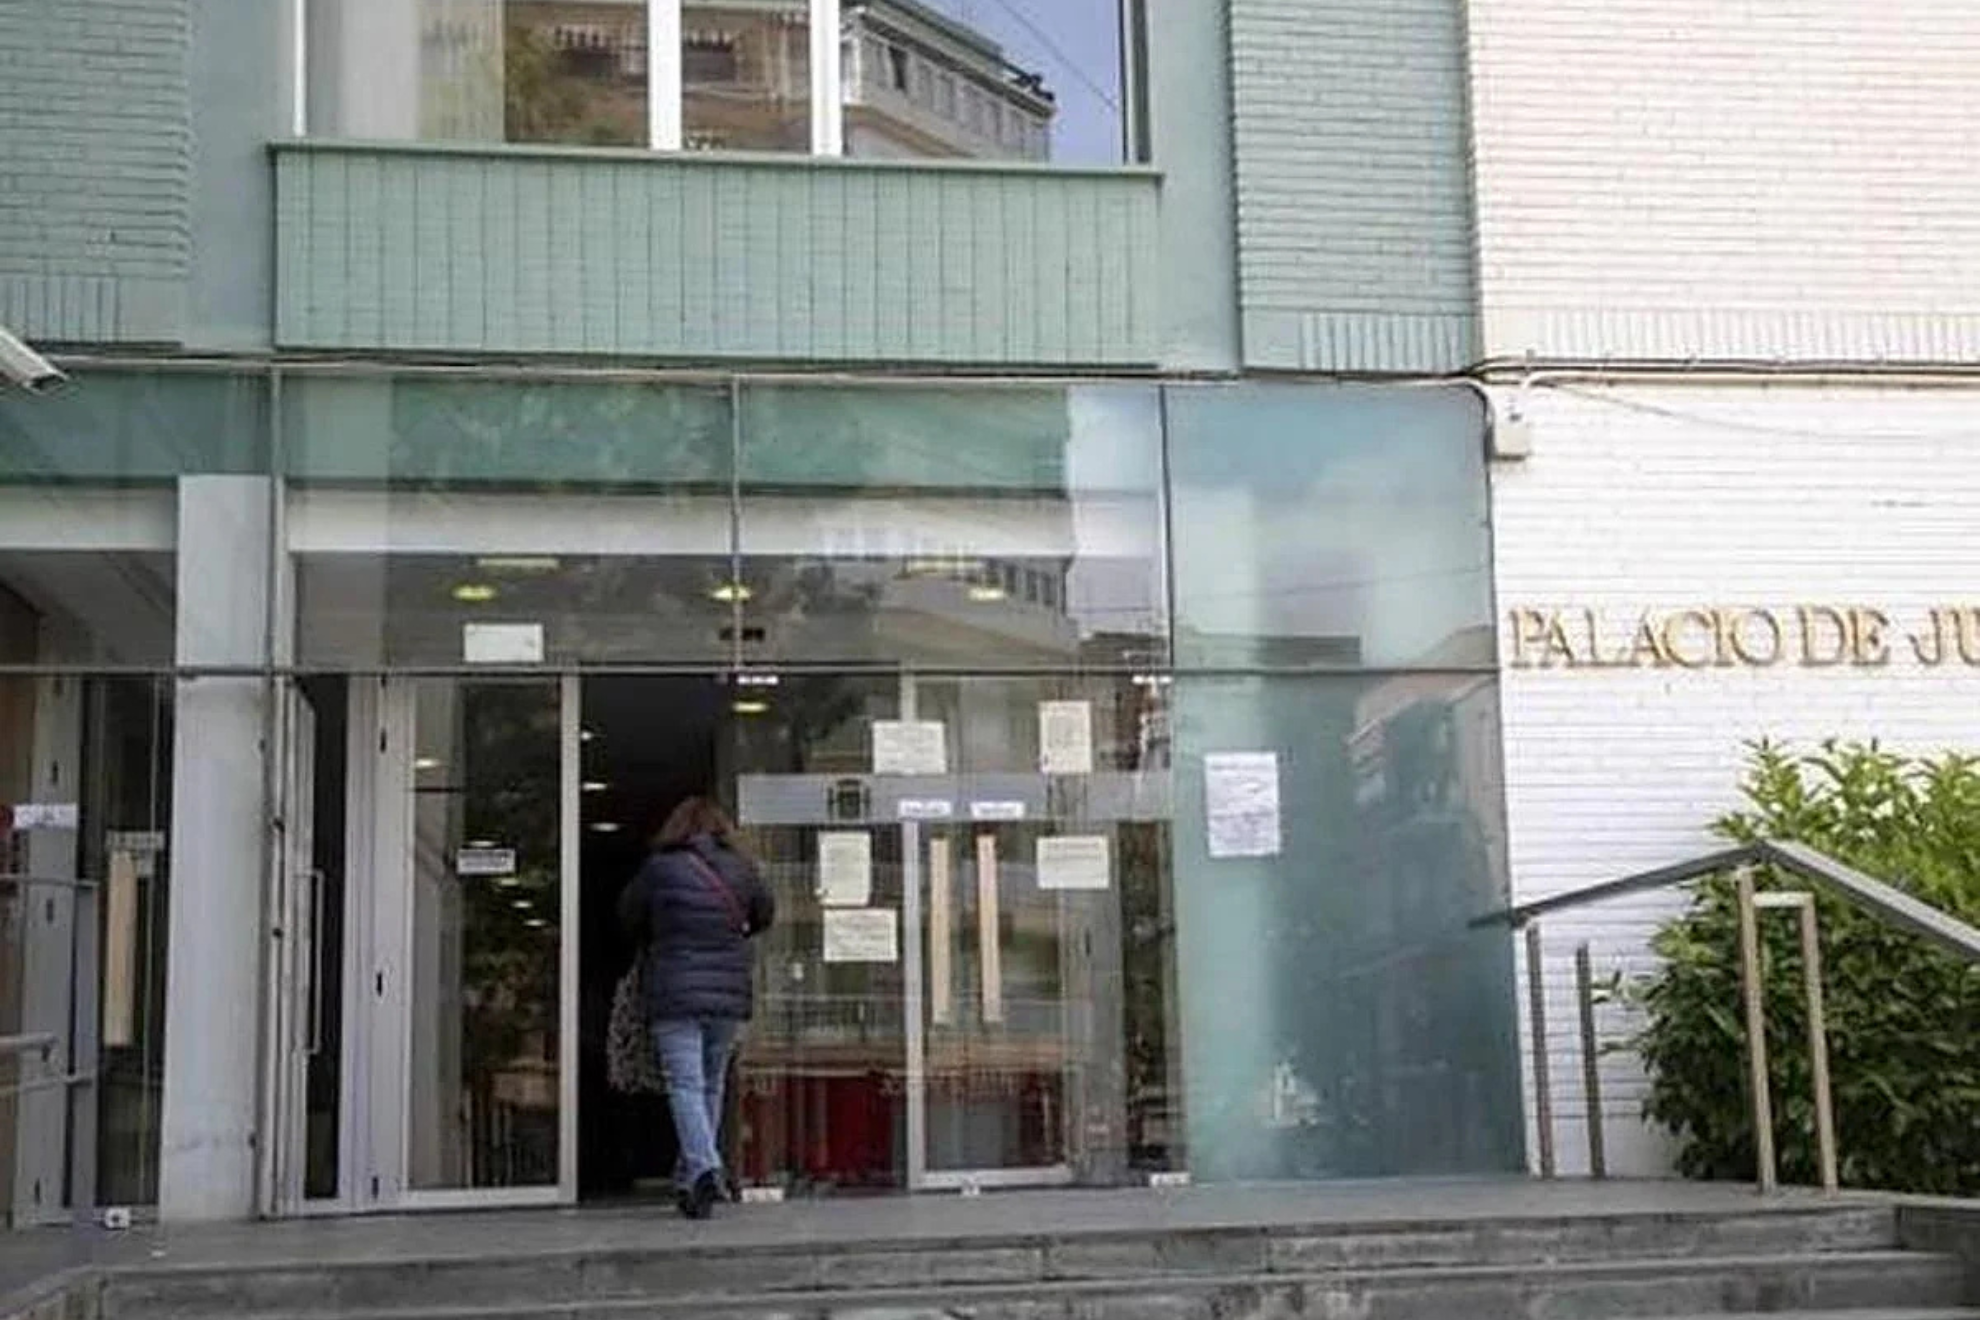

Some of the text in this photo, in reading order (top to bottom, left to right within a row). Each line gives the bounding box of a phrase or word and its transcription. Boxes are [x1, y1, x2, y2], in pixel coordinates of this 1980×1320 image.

[1508, 605, 1980, 669] PALACIO DE JU
